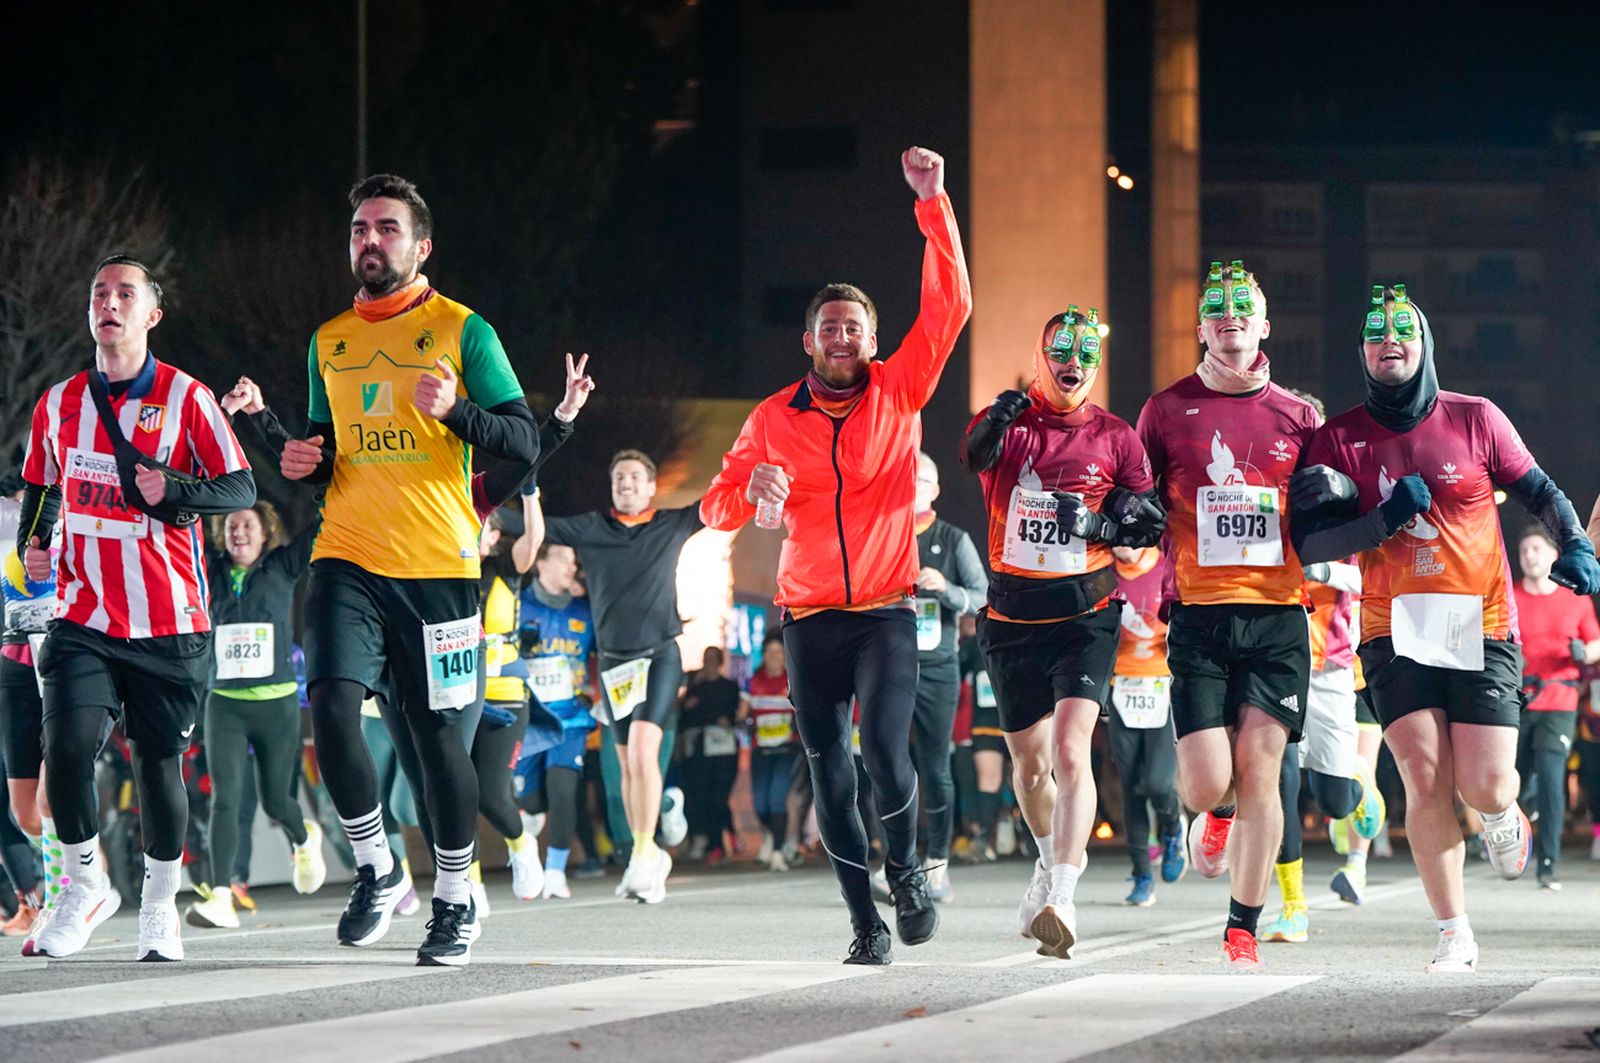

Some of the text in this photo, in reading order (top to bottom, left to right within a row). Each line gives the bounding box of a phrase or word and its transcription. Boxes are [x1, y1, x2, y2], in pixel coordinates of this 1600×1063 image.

[349, 422, 416, 454] Jaén
[384, 452, 431, 463] INTERIOR
[84, 461, 109, 473] NOCHE
[72, 468, 89, 479] SAN
[1217, 494, 1244, 502] NOCHE
[1047, 501, 1057, 509] DE
[1208, 503, 1226, 513] SAN
[1216, 514, 1267, 538] 6973
[445, 628, 470, 640] NOCHE
[436, 641, 453, 653] SAN
[1125, 695, 1156, 710] 7133
